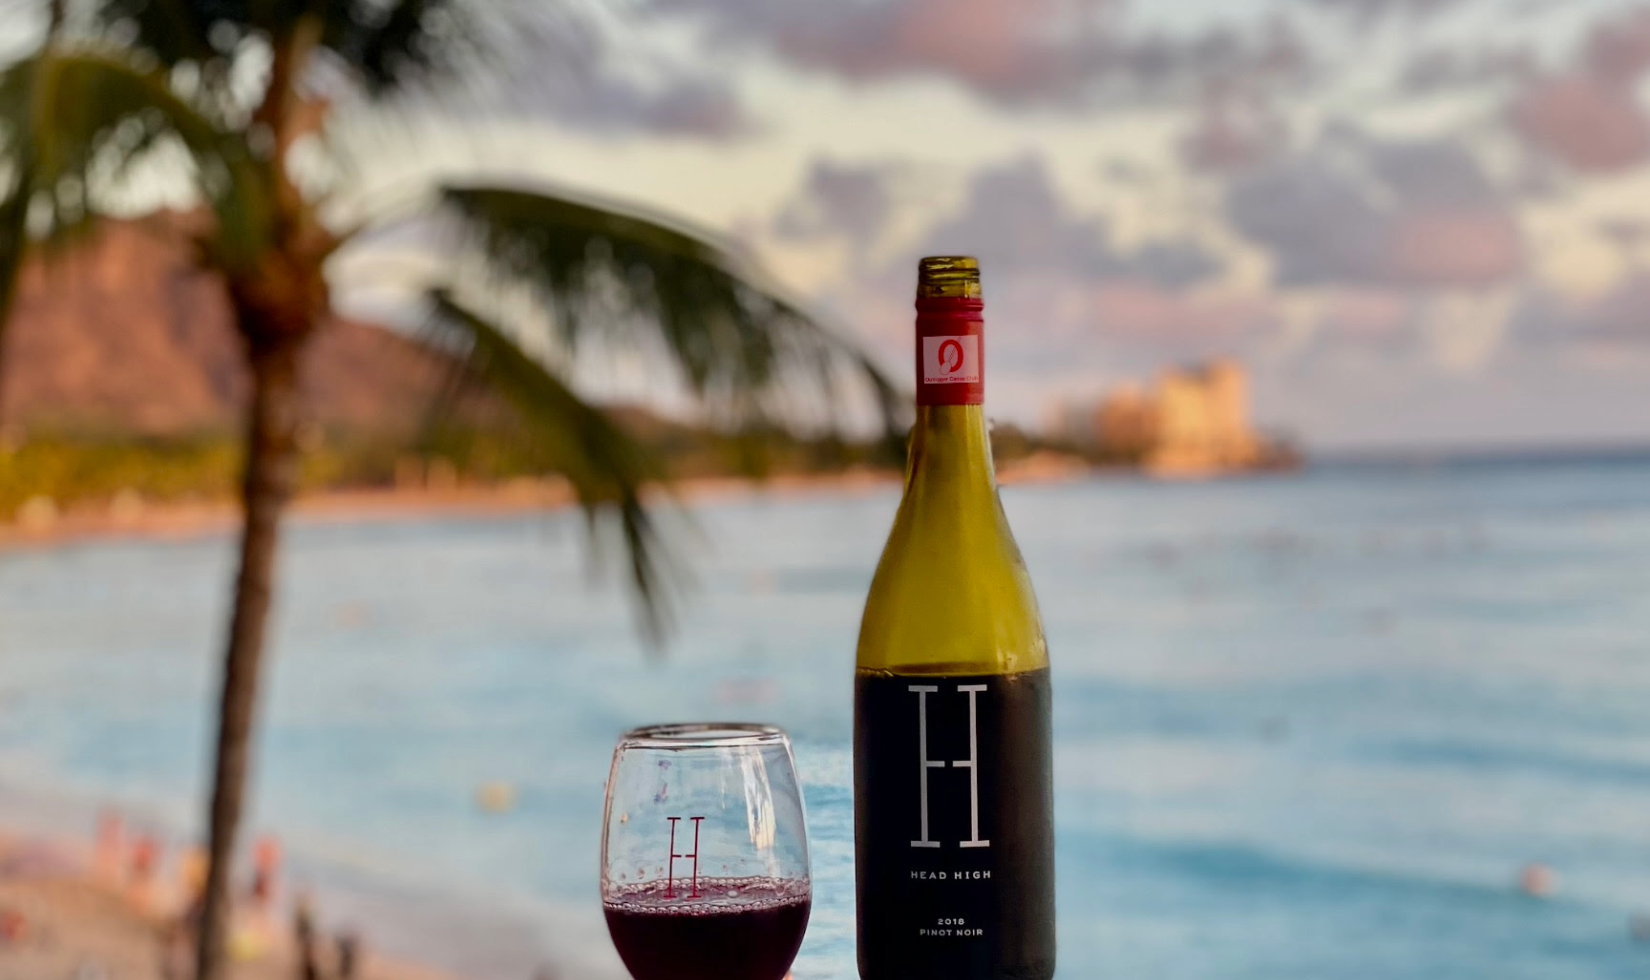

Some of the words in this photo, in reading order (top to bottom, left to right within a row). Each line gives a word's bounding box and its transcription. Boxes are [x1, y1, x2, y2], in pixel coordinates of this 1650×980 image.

[910, 870, 947, 880] HEAD
[954, 870, 992, 880] HIGH
[937, 917, 965, 926] 2018
[919, 928, 953, 937] PINOT
[956, 928, 984, 937] NOIR
